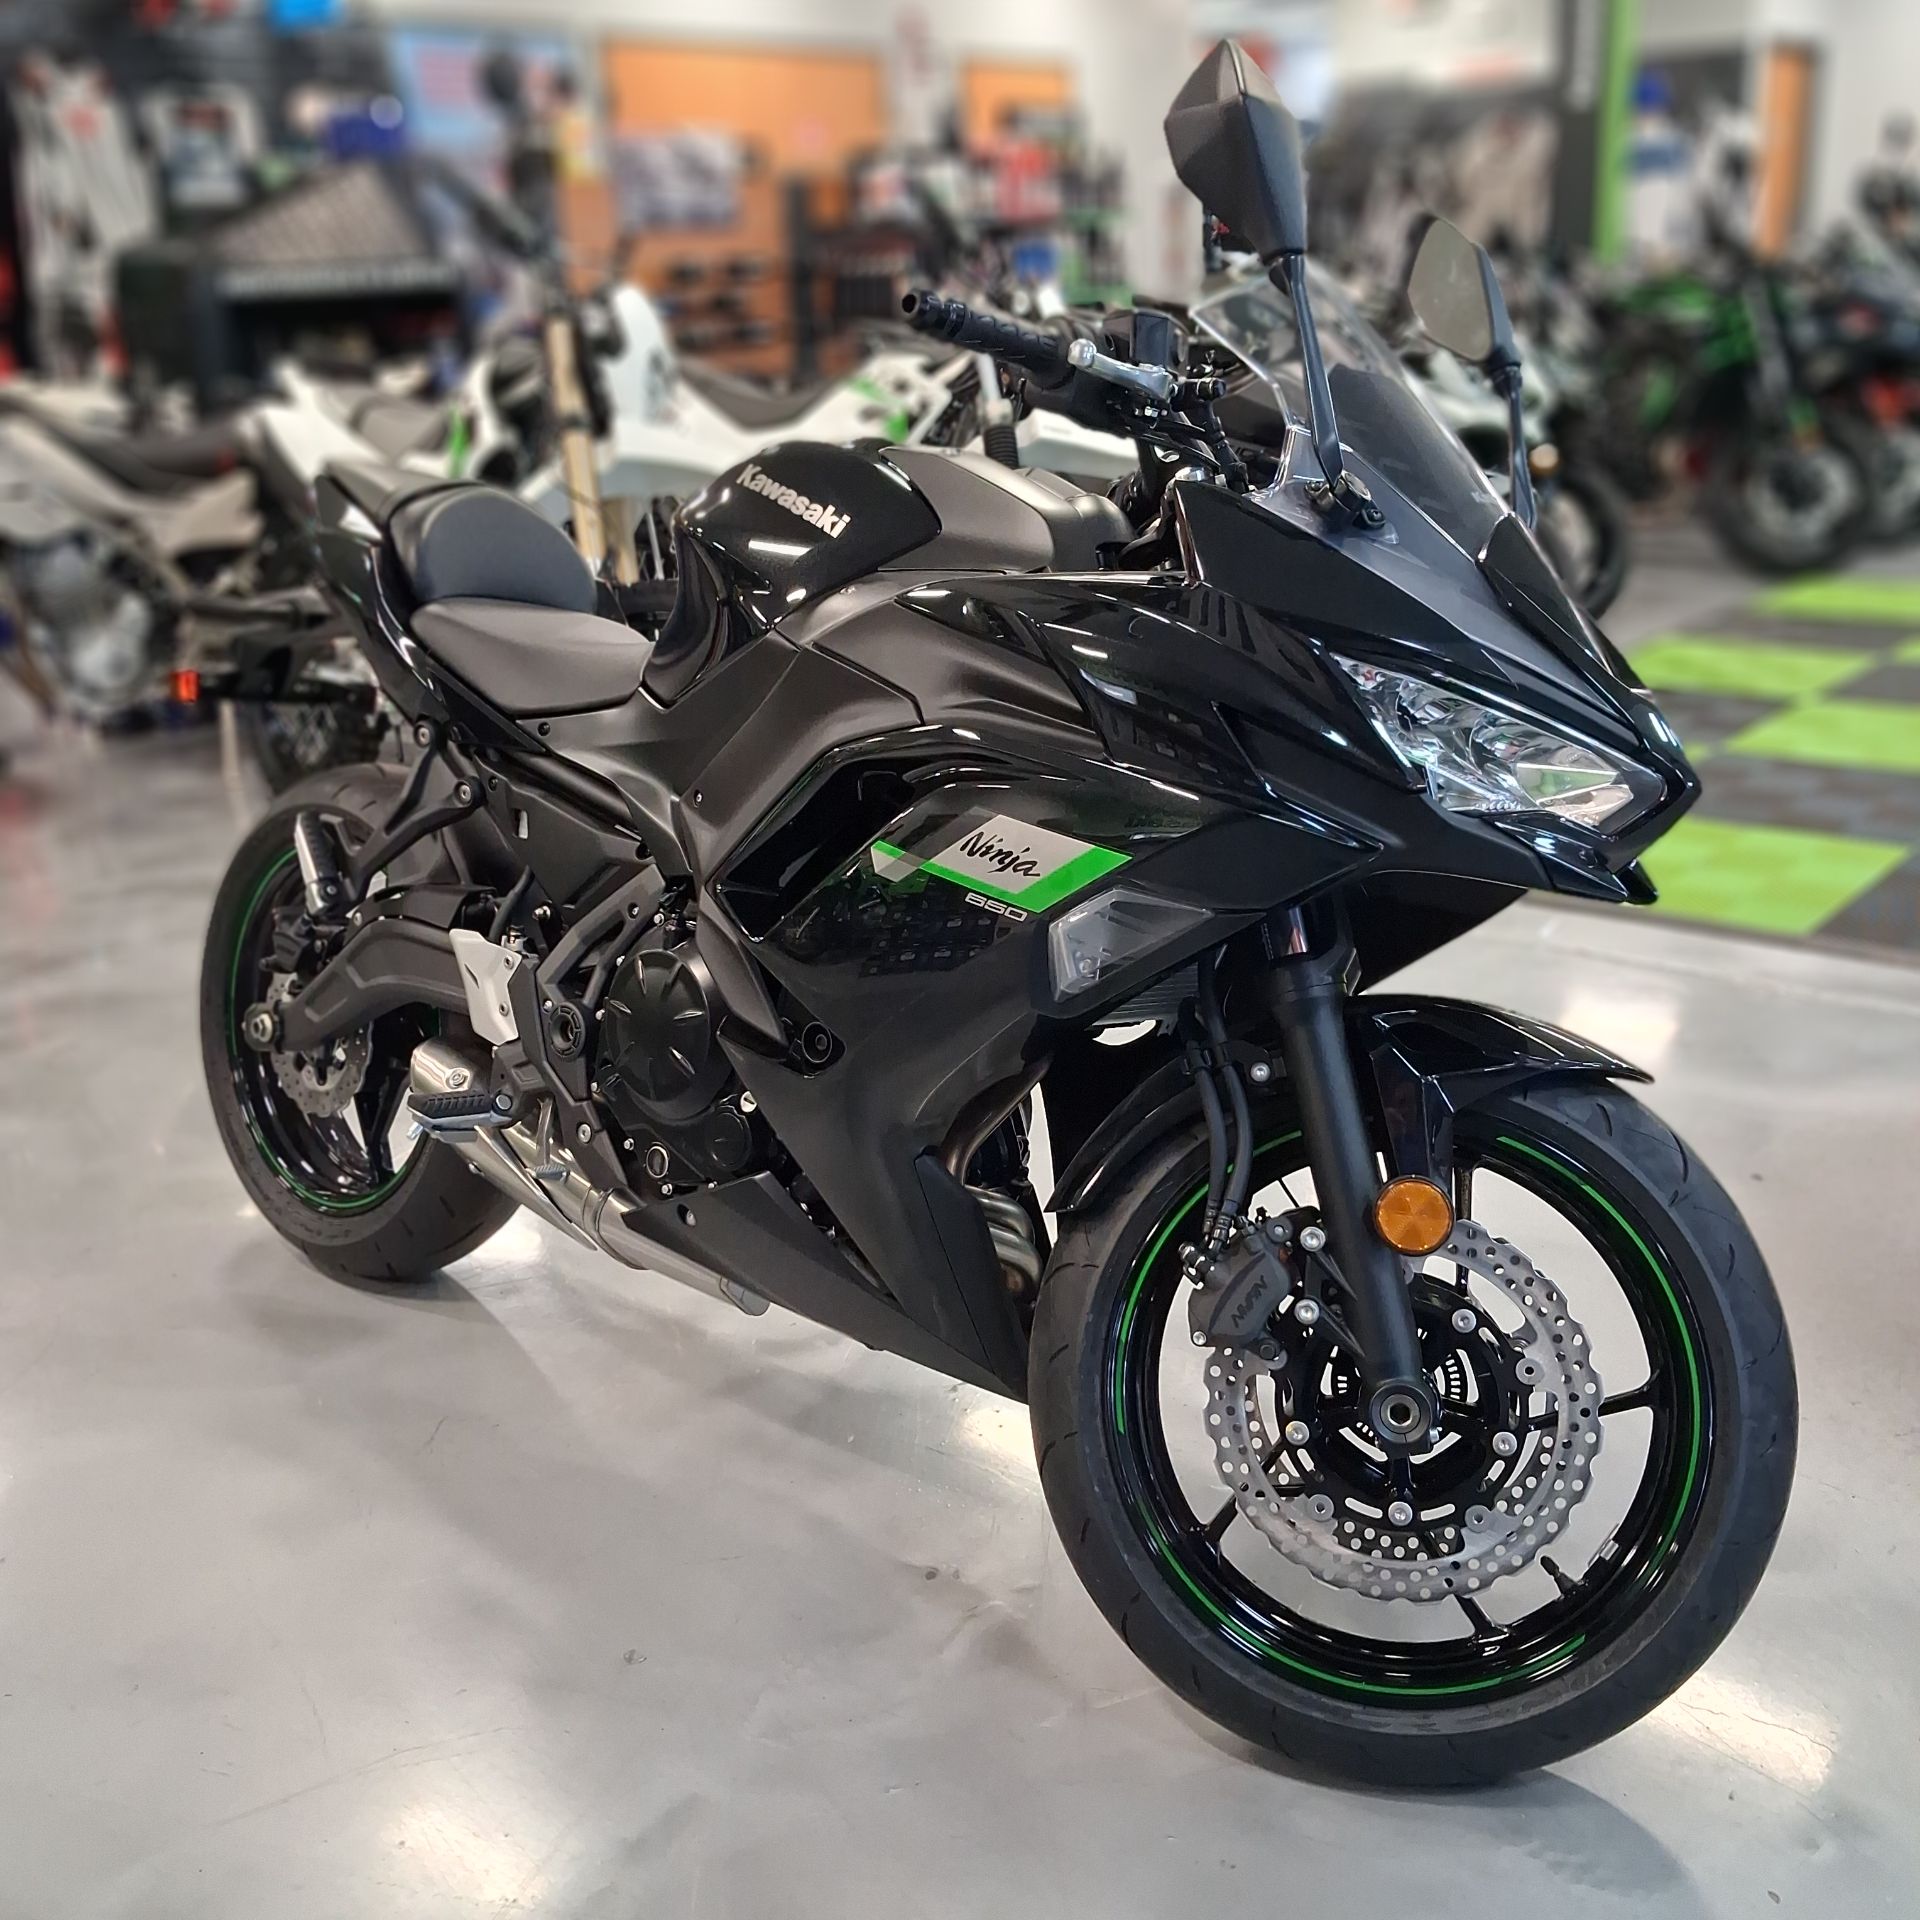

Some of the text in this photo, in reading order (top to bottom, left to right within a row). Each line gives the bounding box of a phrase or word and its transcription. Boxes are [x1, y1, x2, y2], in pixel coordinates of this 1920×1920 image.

[736, 463, 851, 538] Kawasaki
[960, 831, 1041, 877] Ninja
[965, 892, 1028, 922] 650
